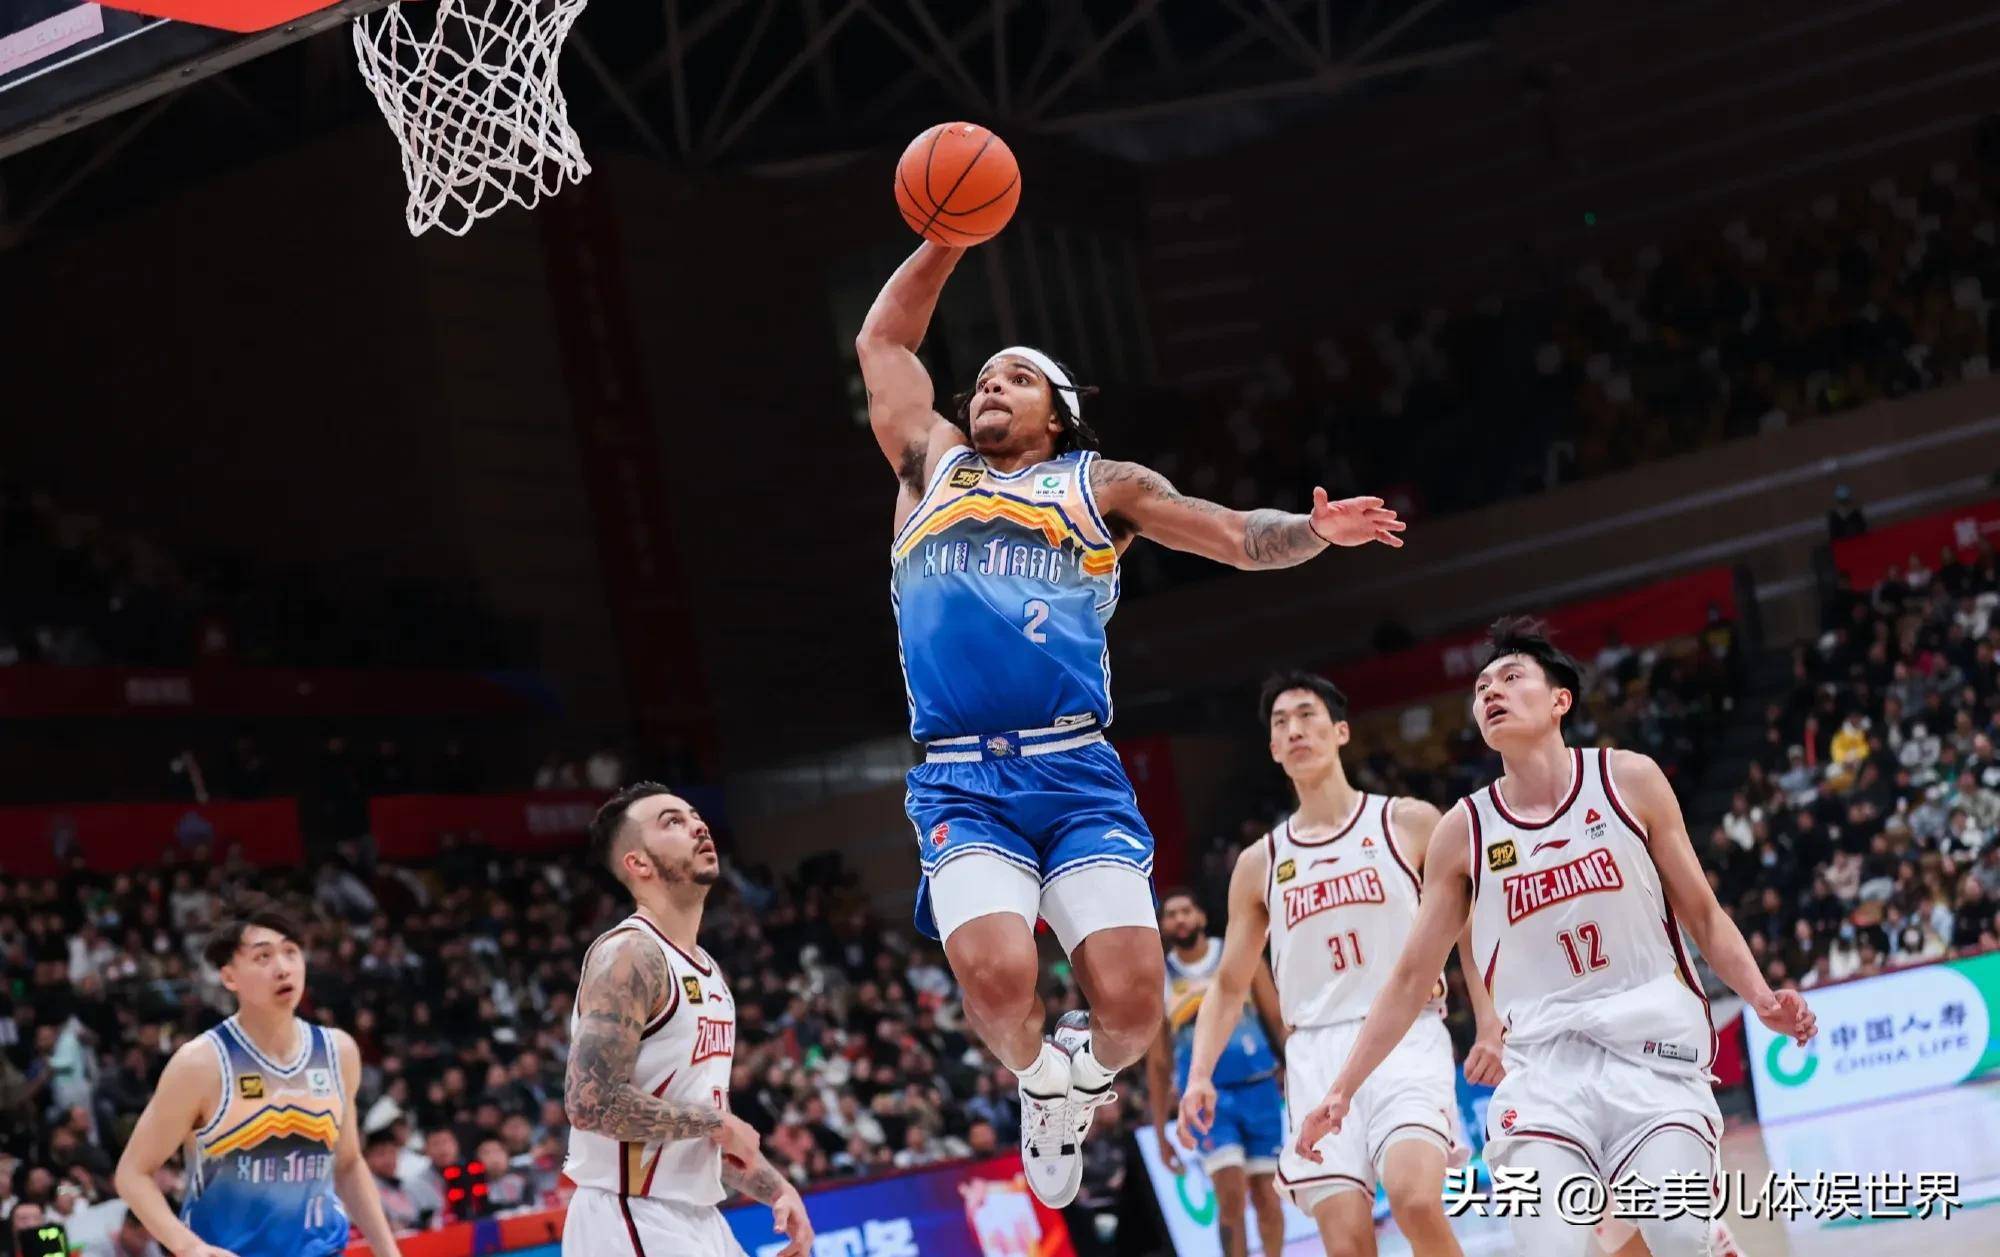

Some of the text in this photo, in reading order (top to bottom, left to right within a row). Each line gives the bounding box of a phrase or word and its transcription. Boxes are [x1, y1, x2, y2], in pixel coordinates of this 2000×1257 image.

[1023, 598, 1050, 644] 2
[1284, 868, 1385, 930] ZHEJIANG
[1504, 848, 1623, 925] ZHEJIANG
[1328, 931, 1363, 972] 31
[1557, 921, 1610, 977] 12
[1831, 1001, 1967, 1050] 中国人寿
[1834, 1034, 1970, 1075] CHINA LIFE
